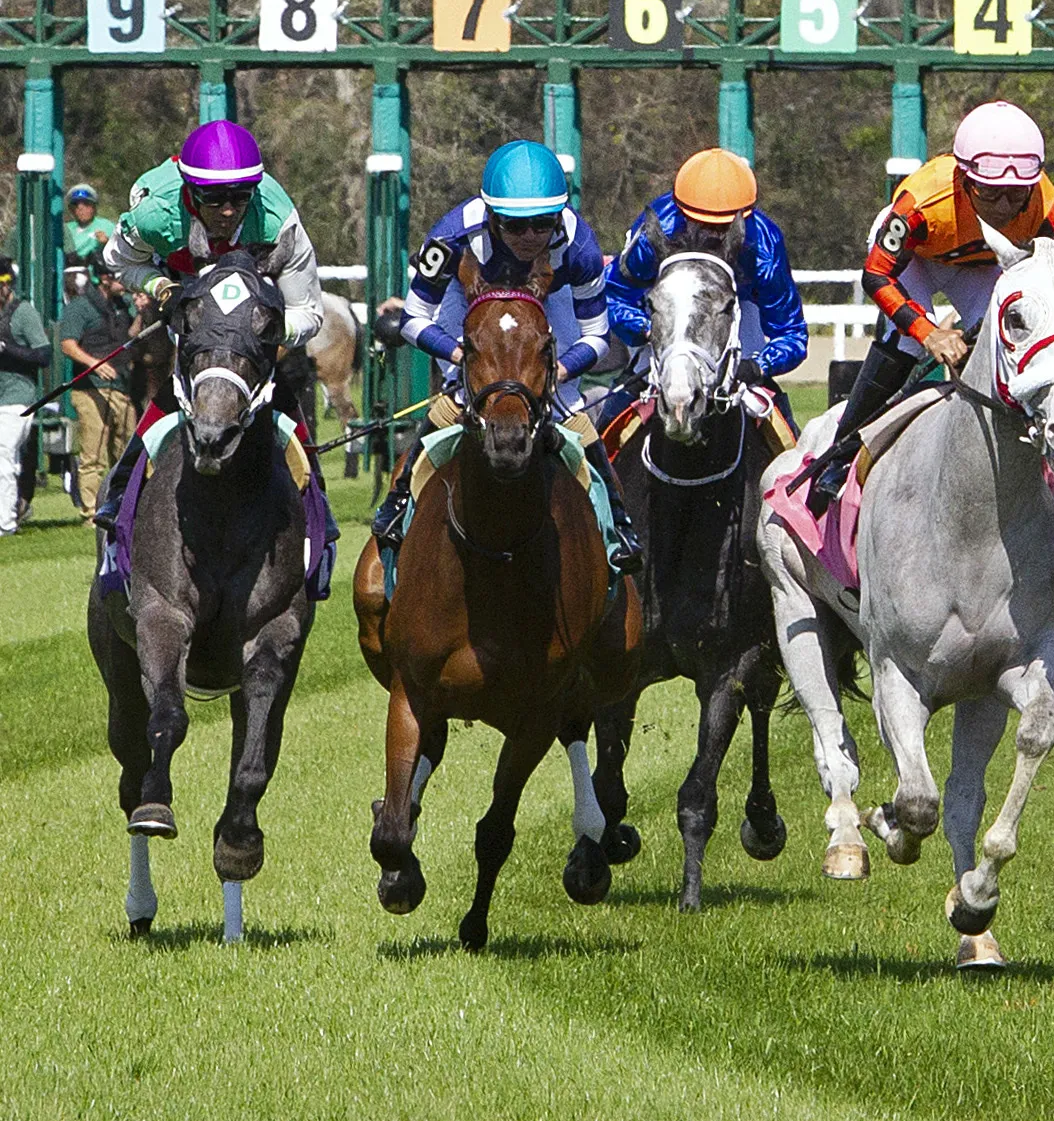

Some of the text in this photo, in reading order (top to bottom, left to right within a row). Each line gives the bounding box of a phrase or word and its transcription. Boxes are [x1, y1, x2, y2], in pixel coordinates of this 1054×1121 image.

[883, 218, 906, 252] 8
[419, 247, 445, 278] 9
[222, 284, 241, 300] D
